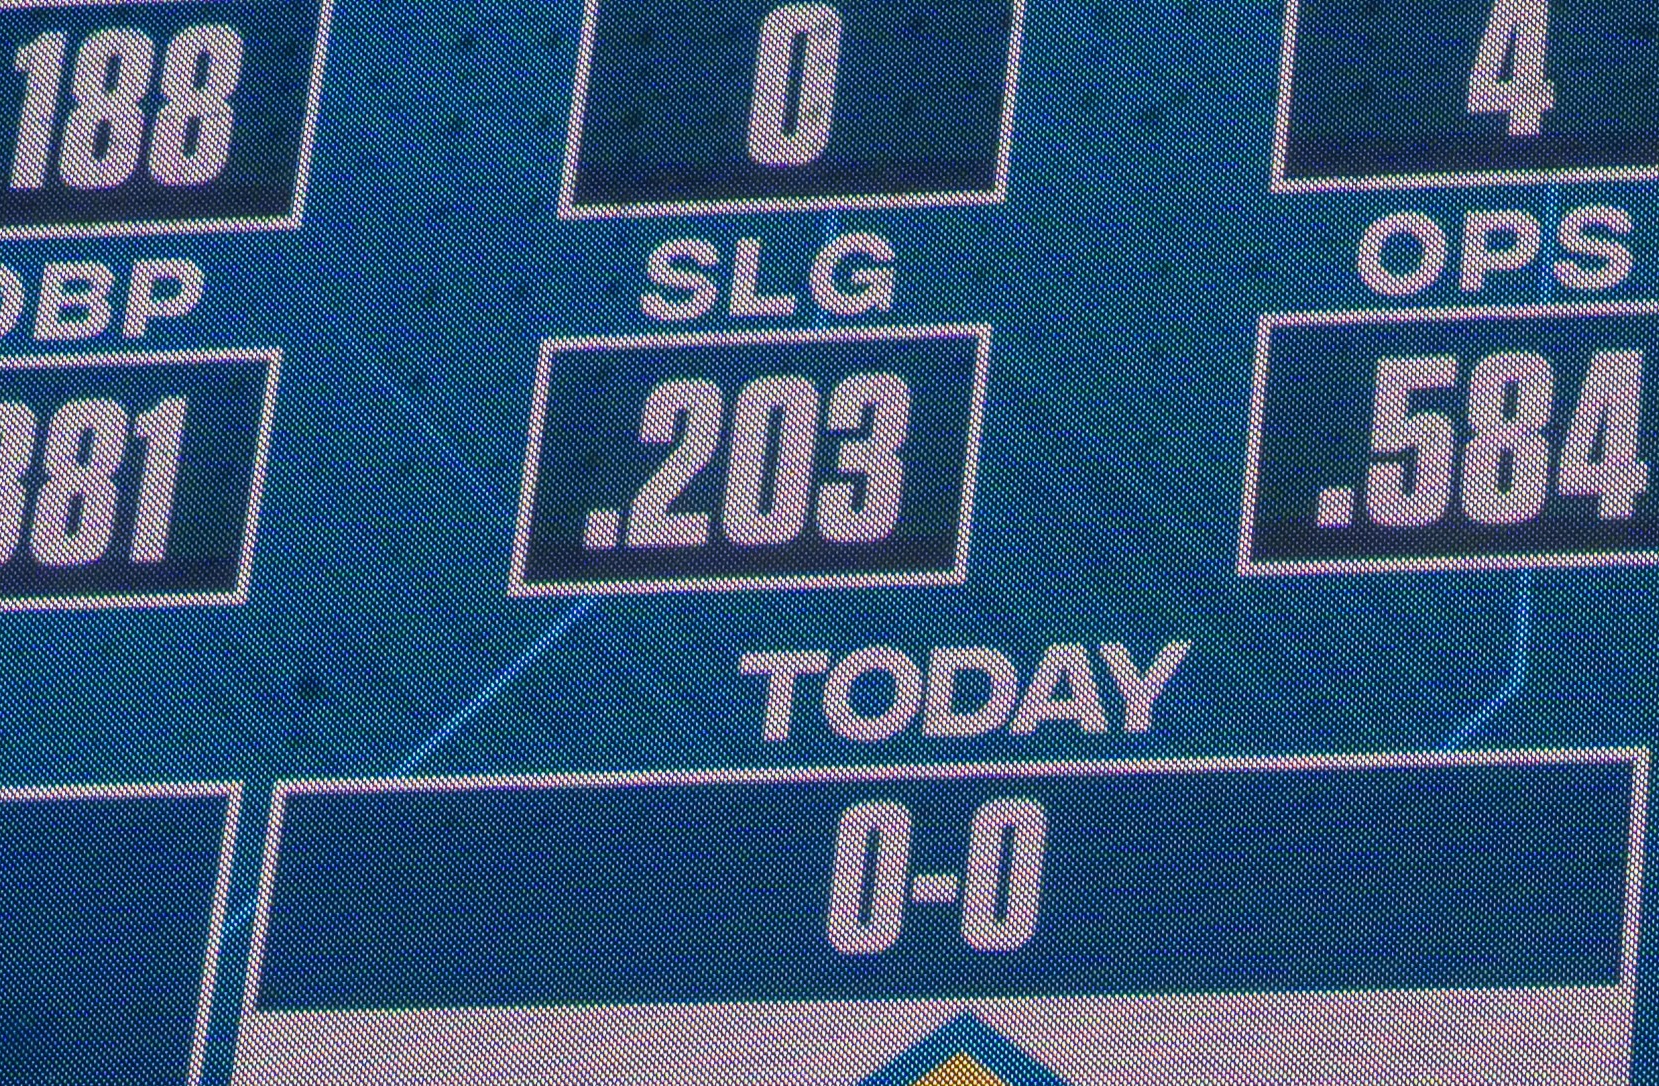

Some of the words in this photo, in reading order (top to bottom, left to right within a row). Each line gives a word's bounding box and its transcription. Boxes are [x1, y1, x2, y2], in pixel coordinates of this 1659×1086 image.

[746, 4, 842, 169] 0
[1468, 0, 1556, 138] 4
[639, 230, 897, 322] SLG
[1356, 204, 1636, 298] OPS
[584, 371, 911, 553] .203
[1316, 348, 1649, 530] .584
[739, 639, 1191, 743] TODAY
[825, 797, 1048, 956] 0-0
